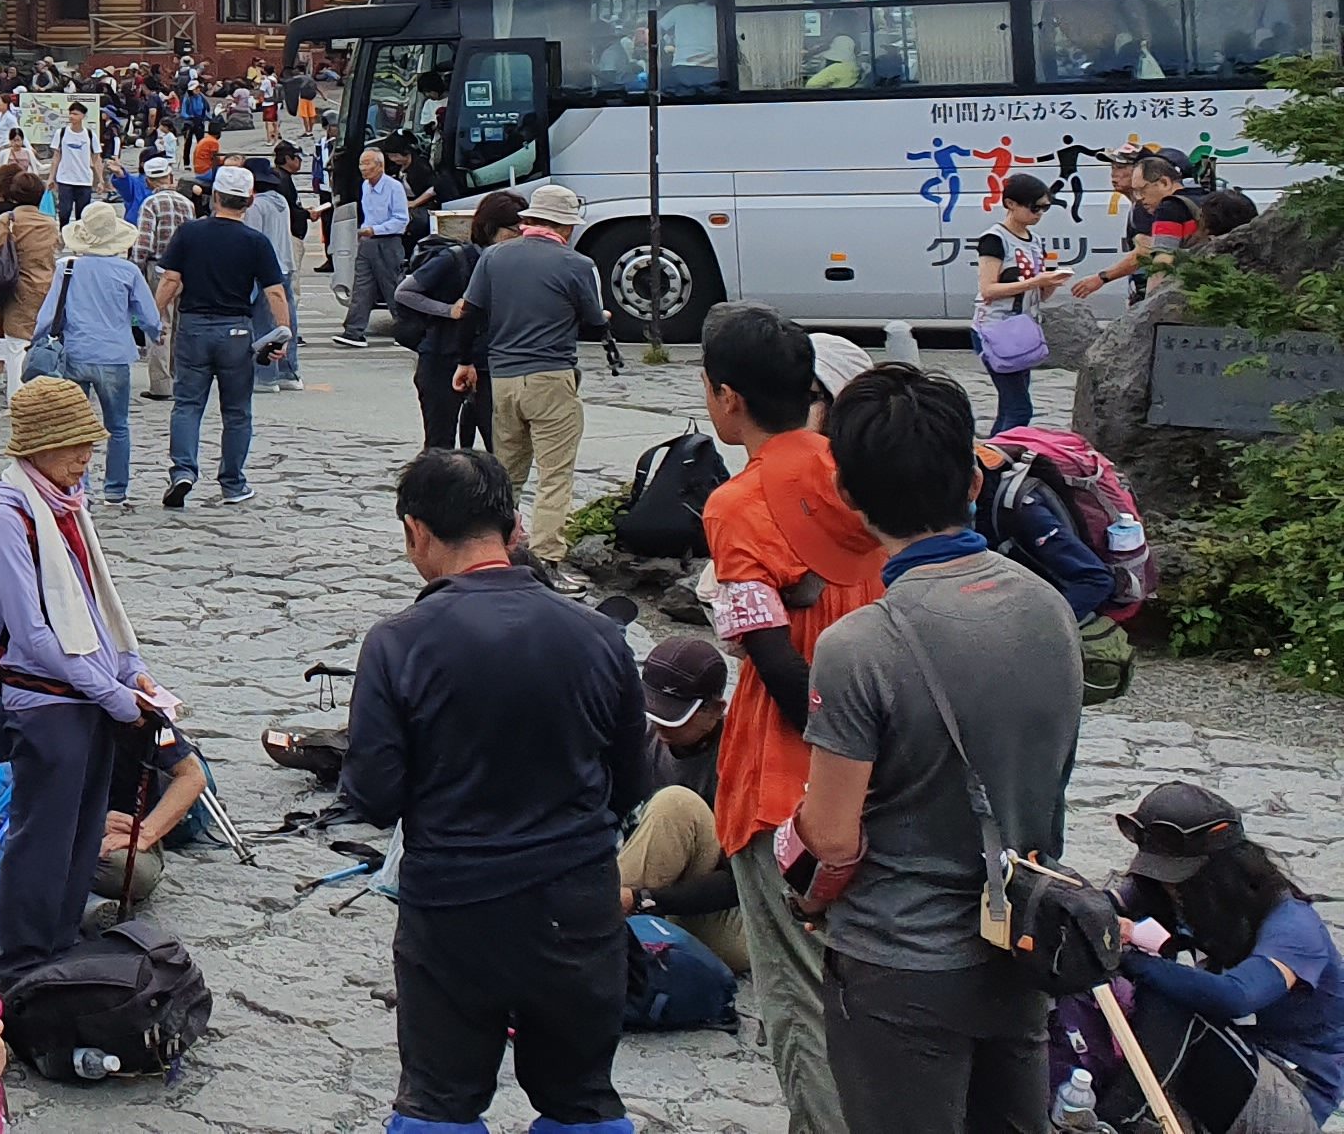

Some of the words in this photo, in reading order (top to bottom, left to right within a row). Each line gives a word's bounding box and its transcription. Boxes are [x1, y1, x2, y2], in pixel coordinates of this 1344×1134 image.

[930, 96, 1219, 125] 仲間が広がる、旅が深まる
